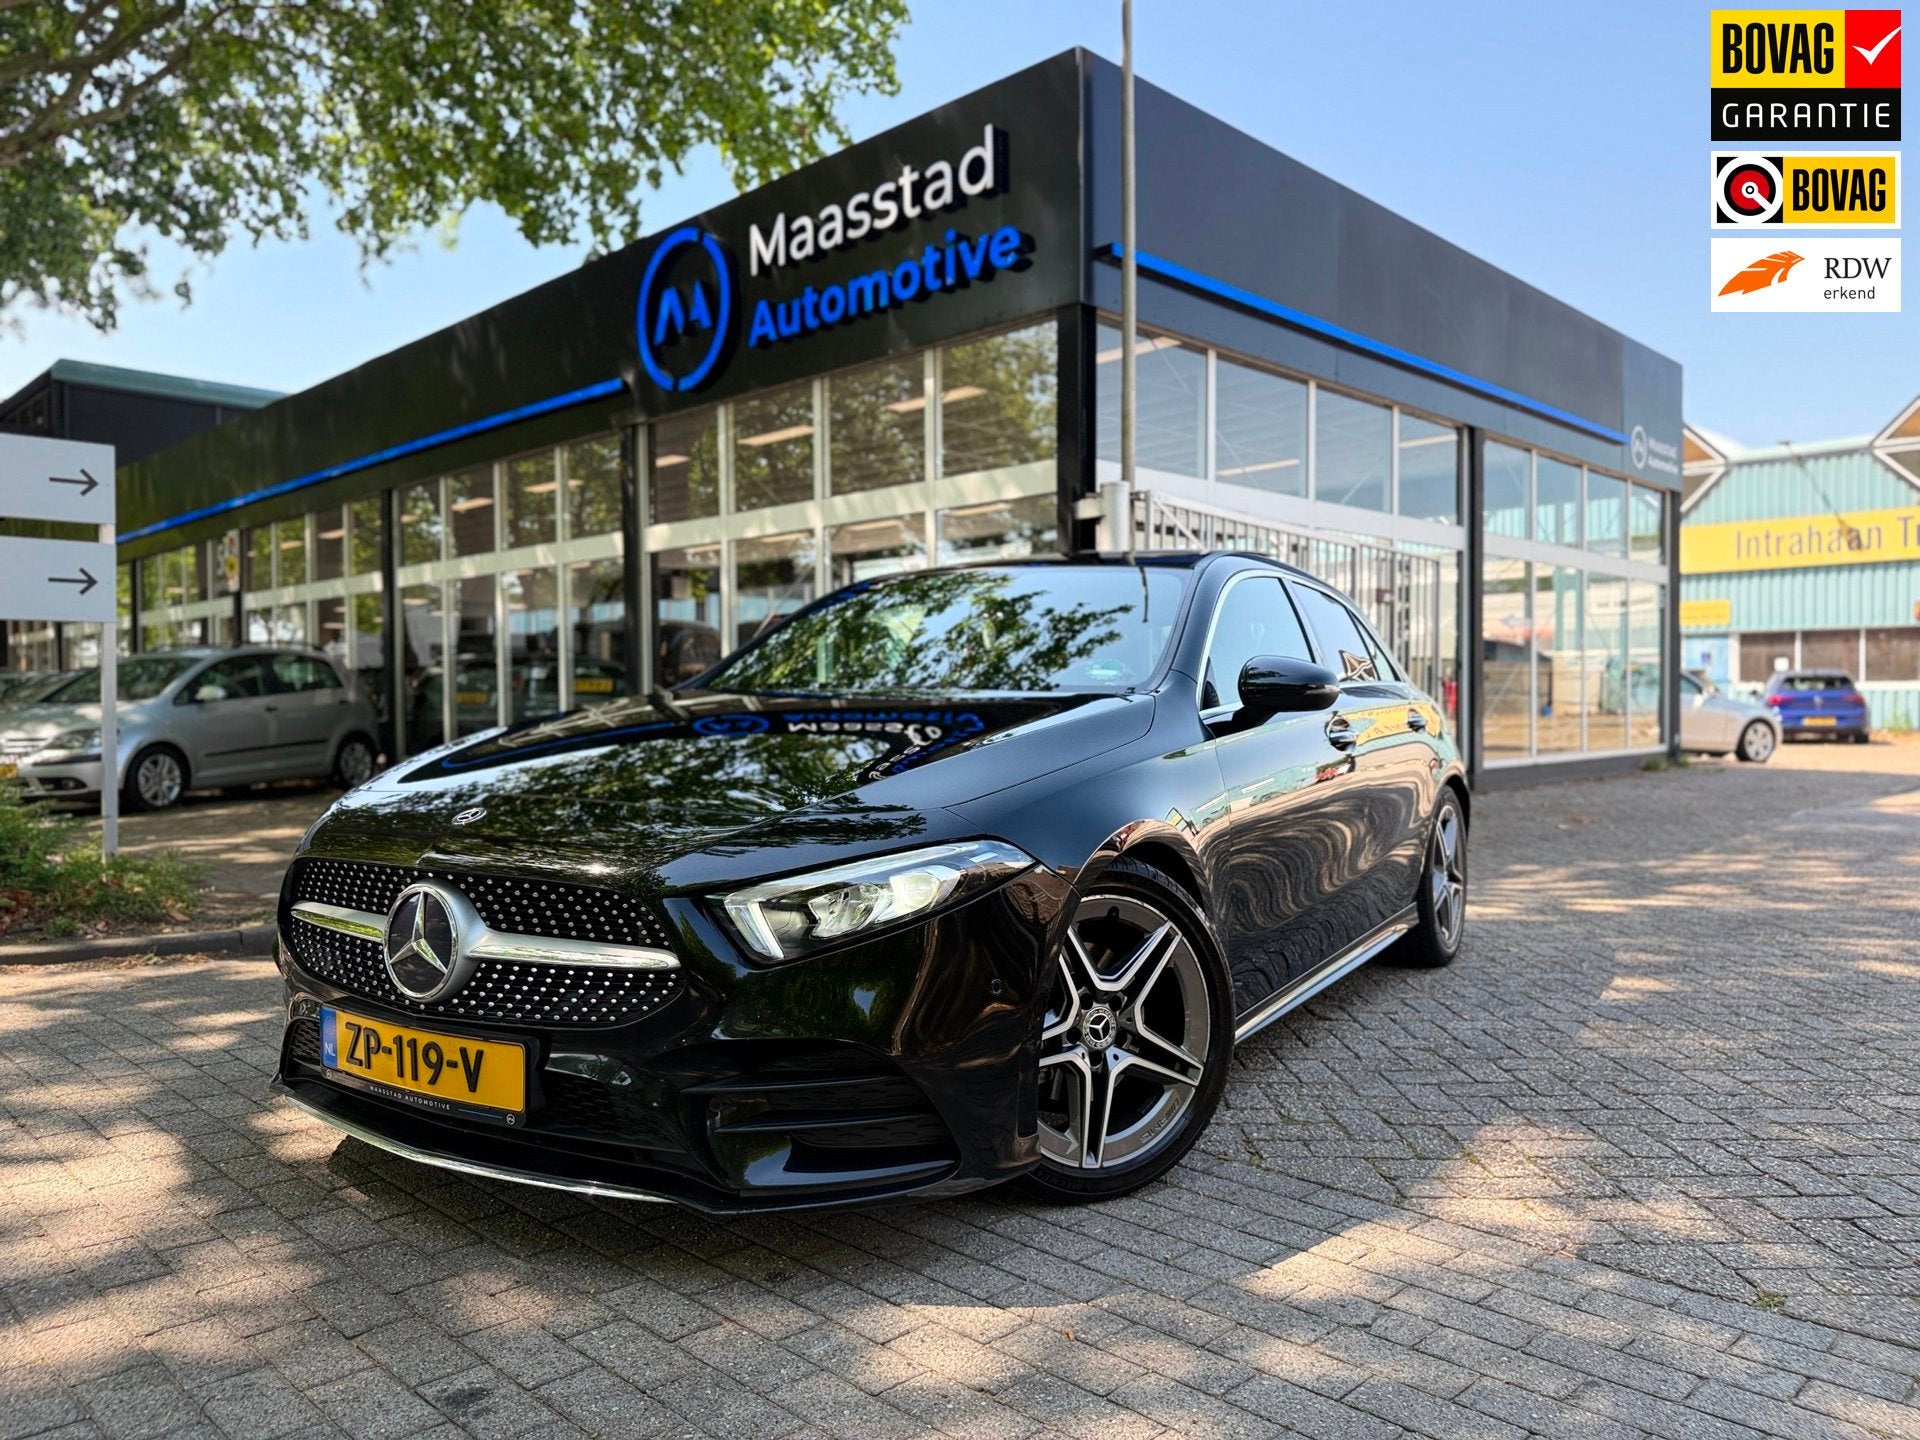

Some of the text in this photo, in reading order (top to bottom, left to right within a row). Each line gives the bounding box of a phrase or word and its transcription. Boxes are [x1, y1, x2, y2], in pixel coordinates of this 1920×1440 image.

[749, 123, 995, 276] Maasstad
[748, 224, 1022, 348] Automotive
[1736, 515, 1920, 560] Intrahaan T
[324, 1040, 337, 1057] NL
[345, 1022, 484, 1093] ZP-119-V
[369, 1085, 451, 1111] MAASSTAD AUTOMOTIVE
